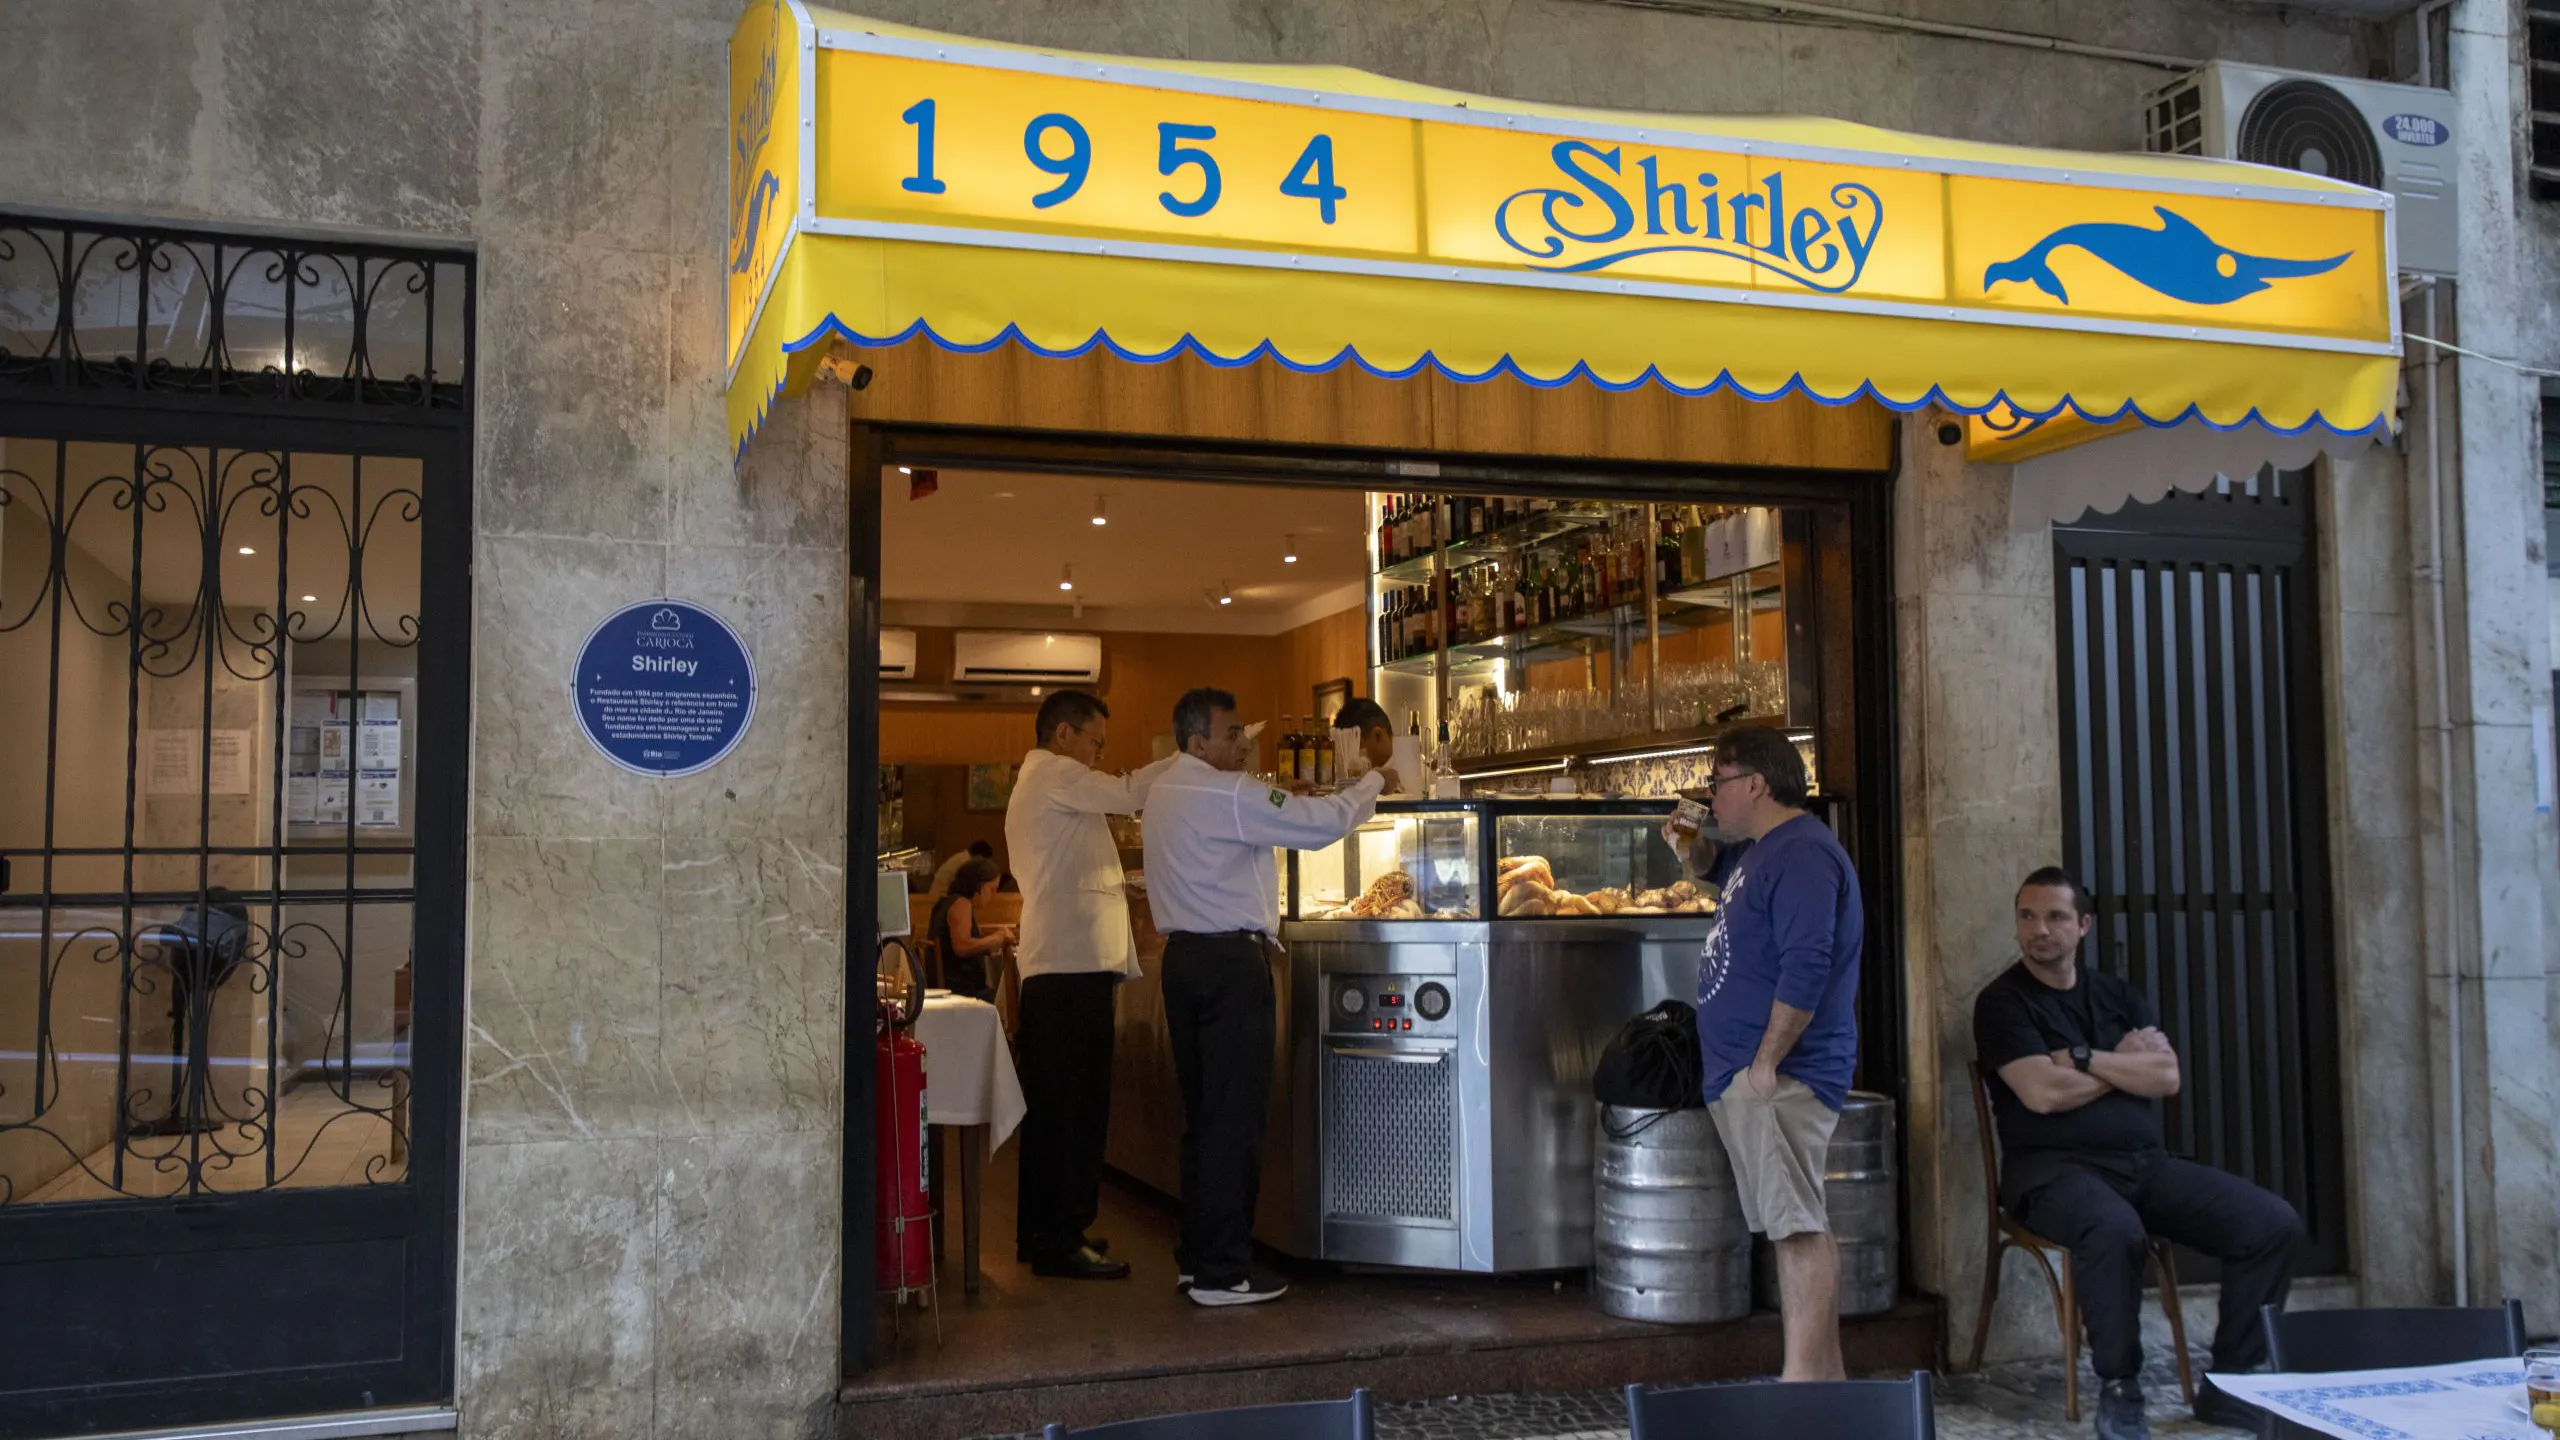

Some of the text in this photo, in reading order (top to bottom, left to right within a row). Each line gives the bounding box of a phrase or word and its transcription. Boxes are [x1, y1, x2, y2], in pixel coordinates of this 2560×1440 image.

[1495, 140, 1883, 293] Shirley
[631, 655, 698, 677] Shirley
[590, 688, 620, 696] Fundado
[597, 696, 639, 705] Restaurante
[640, 697, 664, 706] Shirley
[640, 706, 663, 714] cidade
[675, 707, 687, 715] Rio
[698, 708, 724, 716] Janeiro.
[602, 713, 616, 721] Seu
[638, 714, 647, 722] foi
[649, 715, 666, 723] dado
[658, 724, 700, 733] homenagem
[663, 732, 687, 741] Shirley
[688, 733, 714, 742] Temple.
